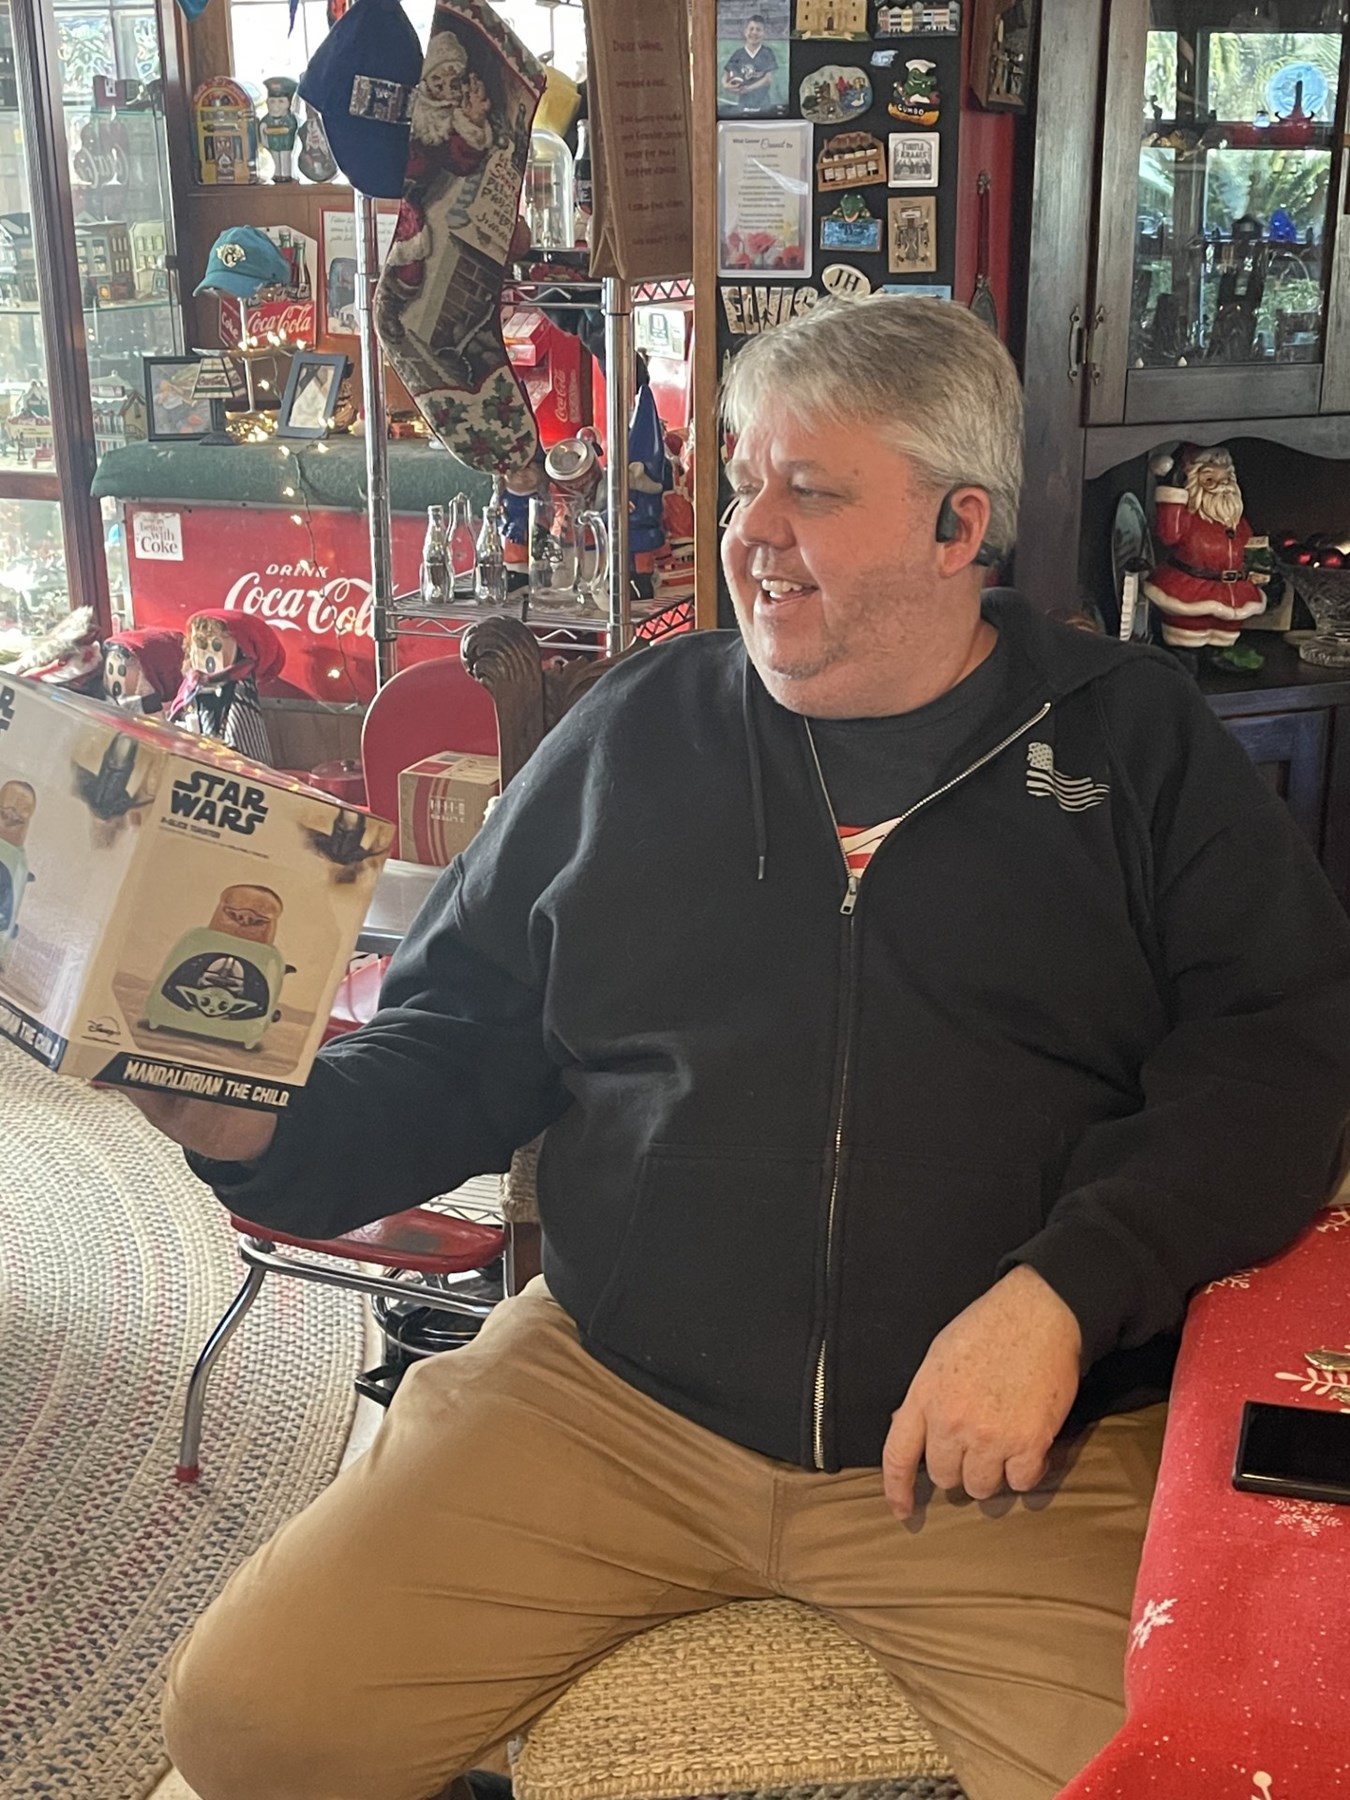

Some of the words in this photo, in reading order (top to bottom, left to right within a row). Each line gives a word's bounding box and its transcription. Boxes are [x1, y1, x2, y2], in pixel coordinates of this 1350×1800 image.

[897, 103, 925, 116] GUMBO
[829, 269, 861, 292] JH
[246, 303, 313, 334] Coca-Cola
[720, 286, 818, 334] ELVIS
[140, 535, 179, 554] Coke
[265, 562, 329, 579] DRINK
[173, 770, 269, 815] STAR
[170, 788, 266, 836] WARS
[122, 1059, 224, 1098] MANDALORIAN
[224, 1079, 252, 1101] THE
[251, 1085, 290, 1107] CHILD
